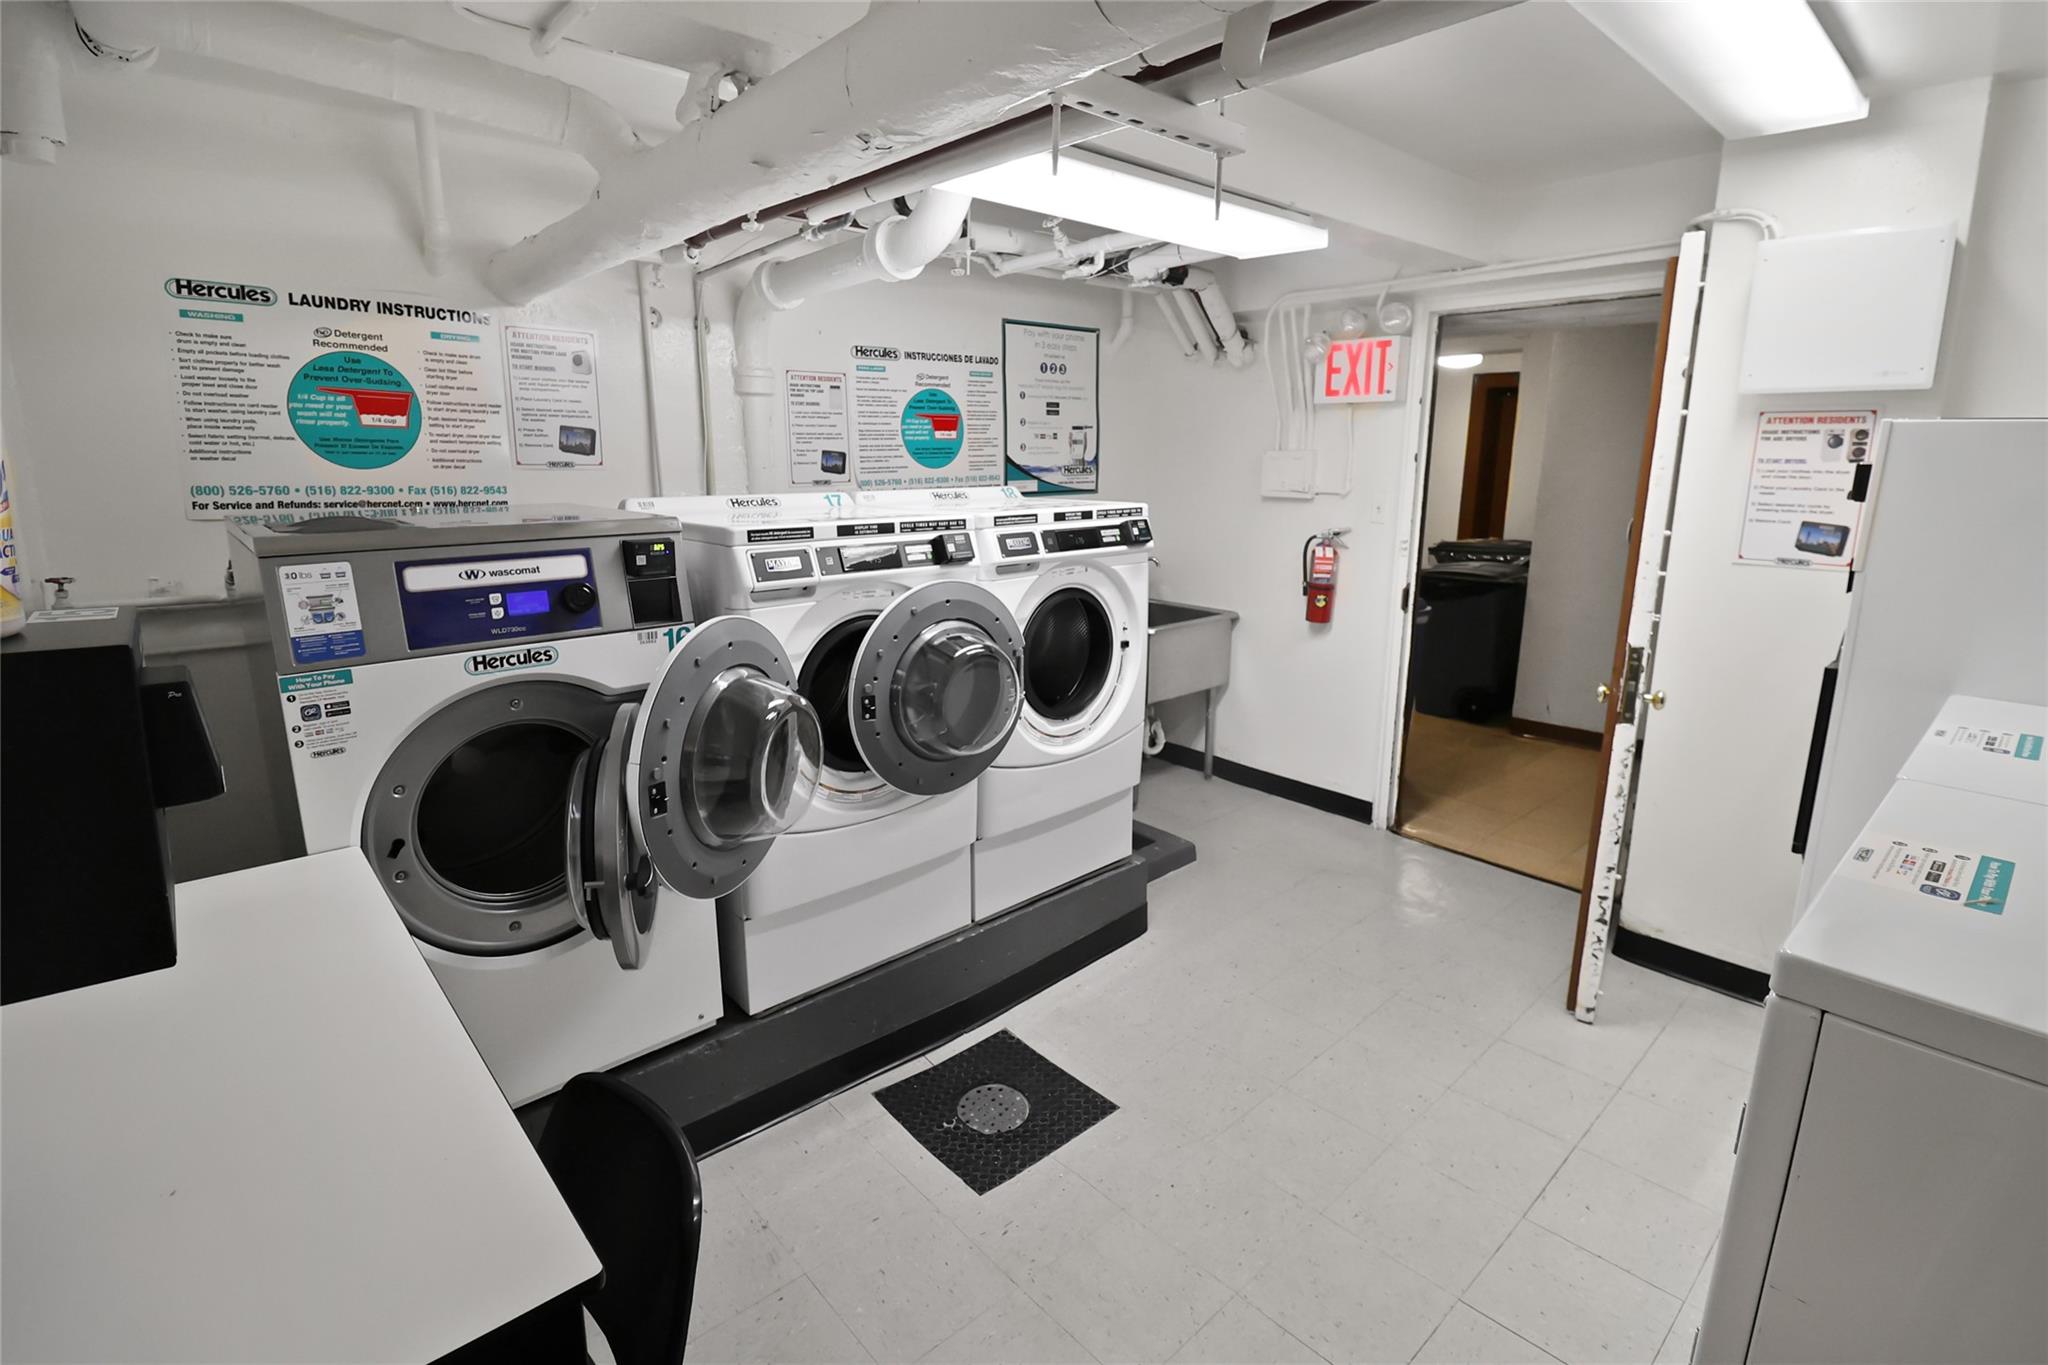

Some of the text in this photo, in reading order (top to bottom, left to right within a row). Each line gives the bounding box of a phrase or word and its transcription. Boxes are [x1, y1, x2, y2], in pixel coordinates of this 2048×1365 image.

[175, 279, 270, 302] Hercules
[187, 311, 236, 320] WASHING
[288, 293, 491, 326] LAUNDRY INSTRUCTIONS
[334, 330, 383, 341] Detergent
[313, 339, 388, 352] Recommended
[856, 346, 898, 359] Hercules
[904, 352, 999, 365] INSTRUCCIONES DE LAVADO
[313, 364, 334, 372] Less
[338, 366, 381, 376] Detergent
[1325, 340, 1392, 397] EXIT
[304, 374, 401, 387] Prevent Over-Sudsing
[1766, 416, 1867, 424] ATTENTION RESIDENTS
[191, 485, 507, 497] (800) 526-5760 (516) 822-9300 Fax (516) 822-9543
[932, 491, 968, 499] Hercules
[193, 501, 209, 510] For
[213, 501, 252, 510] Service
[256, 501, 273, 509] and
[278, 500, 320, 509] Refunds:
[730, 498, 778, 508] Hercules
[824, 494, 842, 507] 17
[489, 566, 540, 577] wascomat
[472, 649, 553, 672] Hercules
